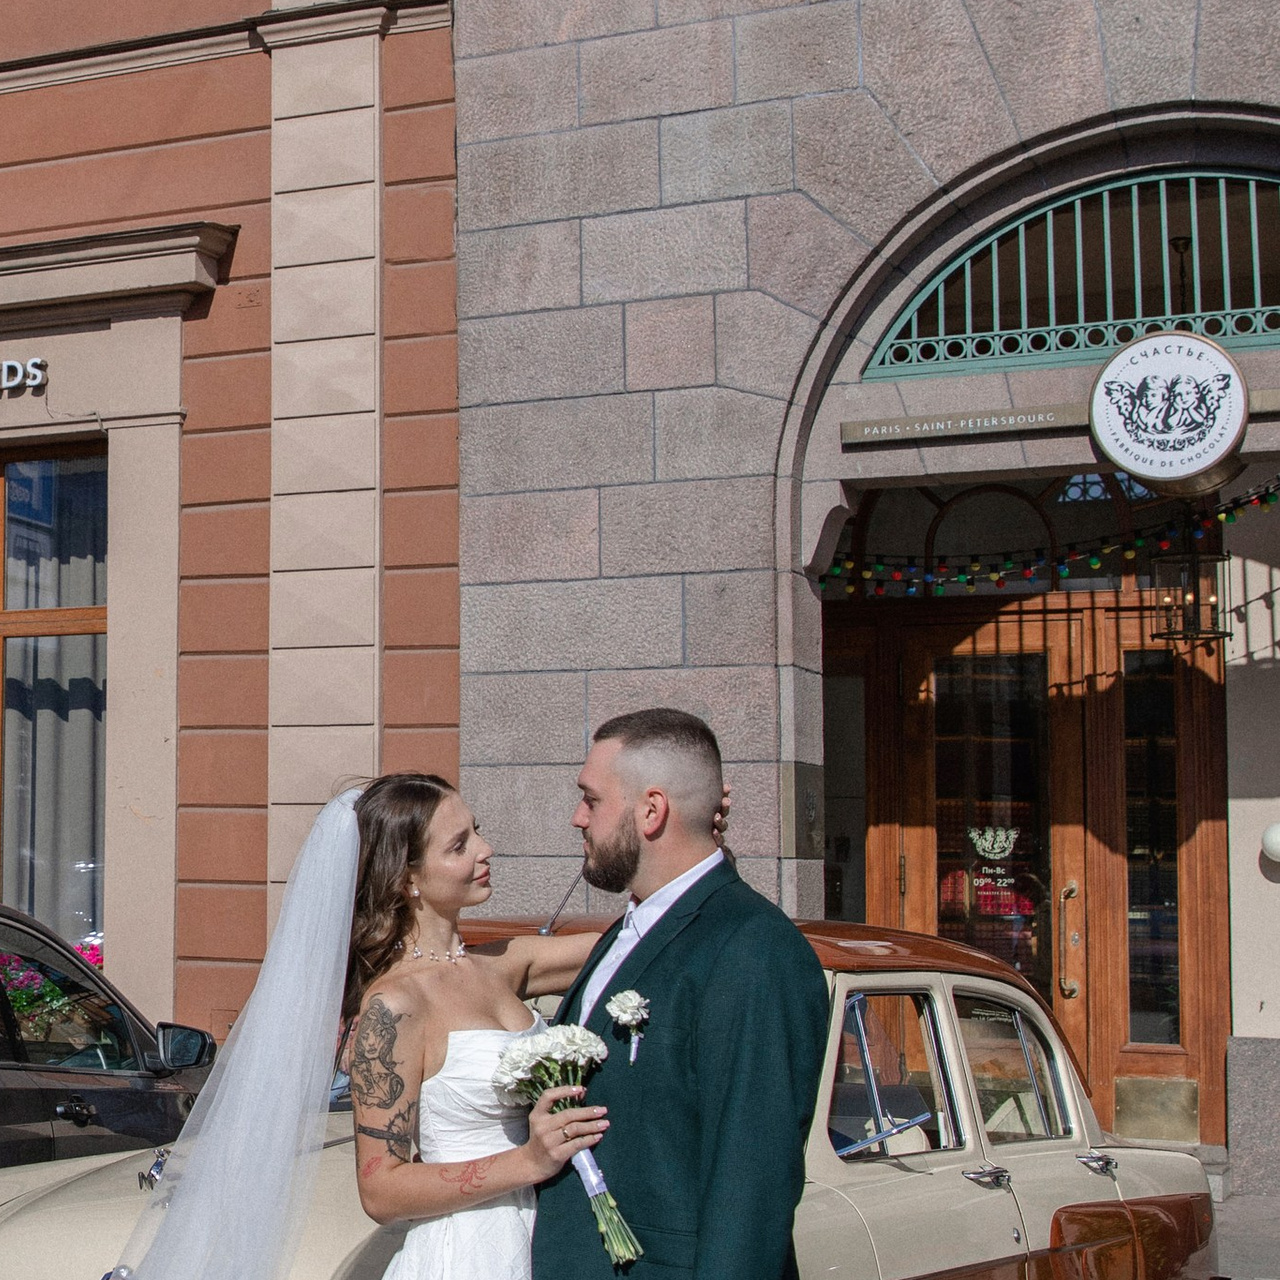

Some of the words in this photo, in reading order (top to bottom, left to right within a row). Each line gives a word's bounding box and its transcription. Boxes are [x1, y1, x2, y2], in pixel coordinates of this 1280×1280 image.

[1129, 345, 1205, 365] СЧАСТЬЕ
[864, 425, 901, 436] PARIS
[914, 413, 1056, 431] SAINT-PETERSBOURG
[1110, 431, 1154, 466] FABRIQUE
[1180, 426, 1228, 465] CHOCOLAT
